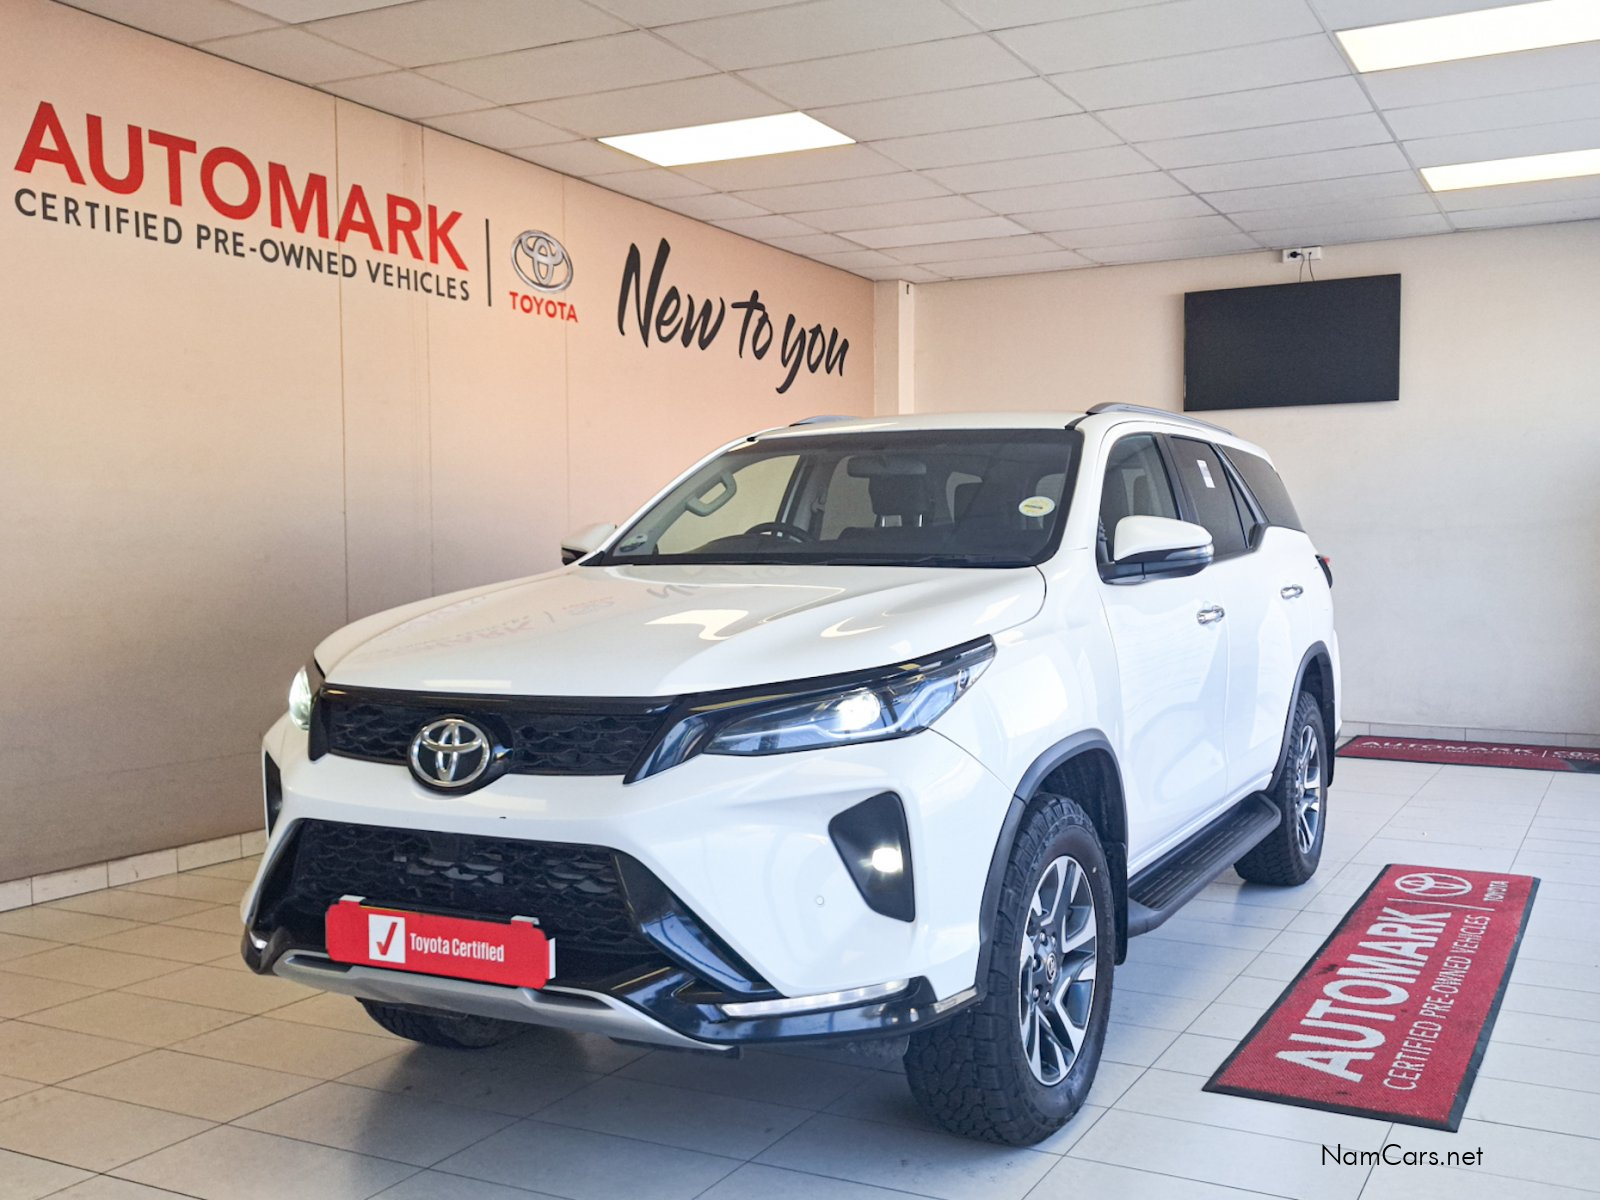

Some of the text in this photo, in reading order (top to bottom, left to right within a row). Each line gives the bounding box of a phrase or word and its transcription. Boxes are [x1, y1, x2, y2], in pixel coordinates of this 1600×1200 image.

[14, 101, 468, 271] AUTOMARK
[15, 188, 469, 301] CERTIFIED PRE-OWNED VEHICLES
[509, 291, 578, 323] TOYOTA
[617, 237, 850, 394] New to you
[410, 933, 505, 962] Toyota Certified
[1483, 880, 1509, 902] TOYOTA
[1276, 906, 1452, 1083] AUTOMARK
[1383, 914, 1491, 1090] CERTIFIED PRE-OWNED VEHICLES
